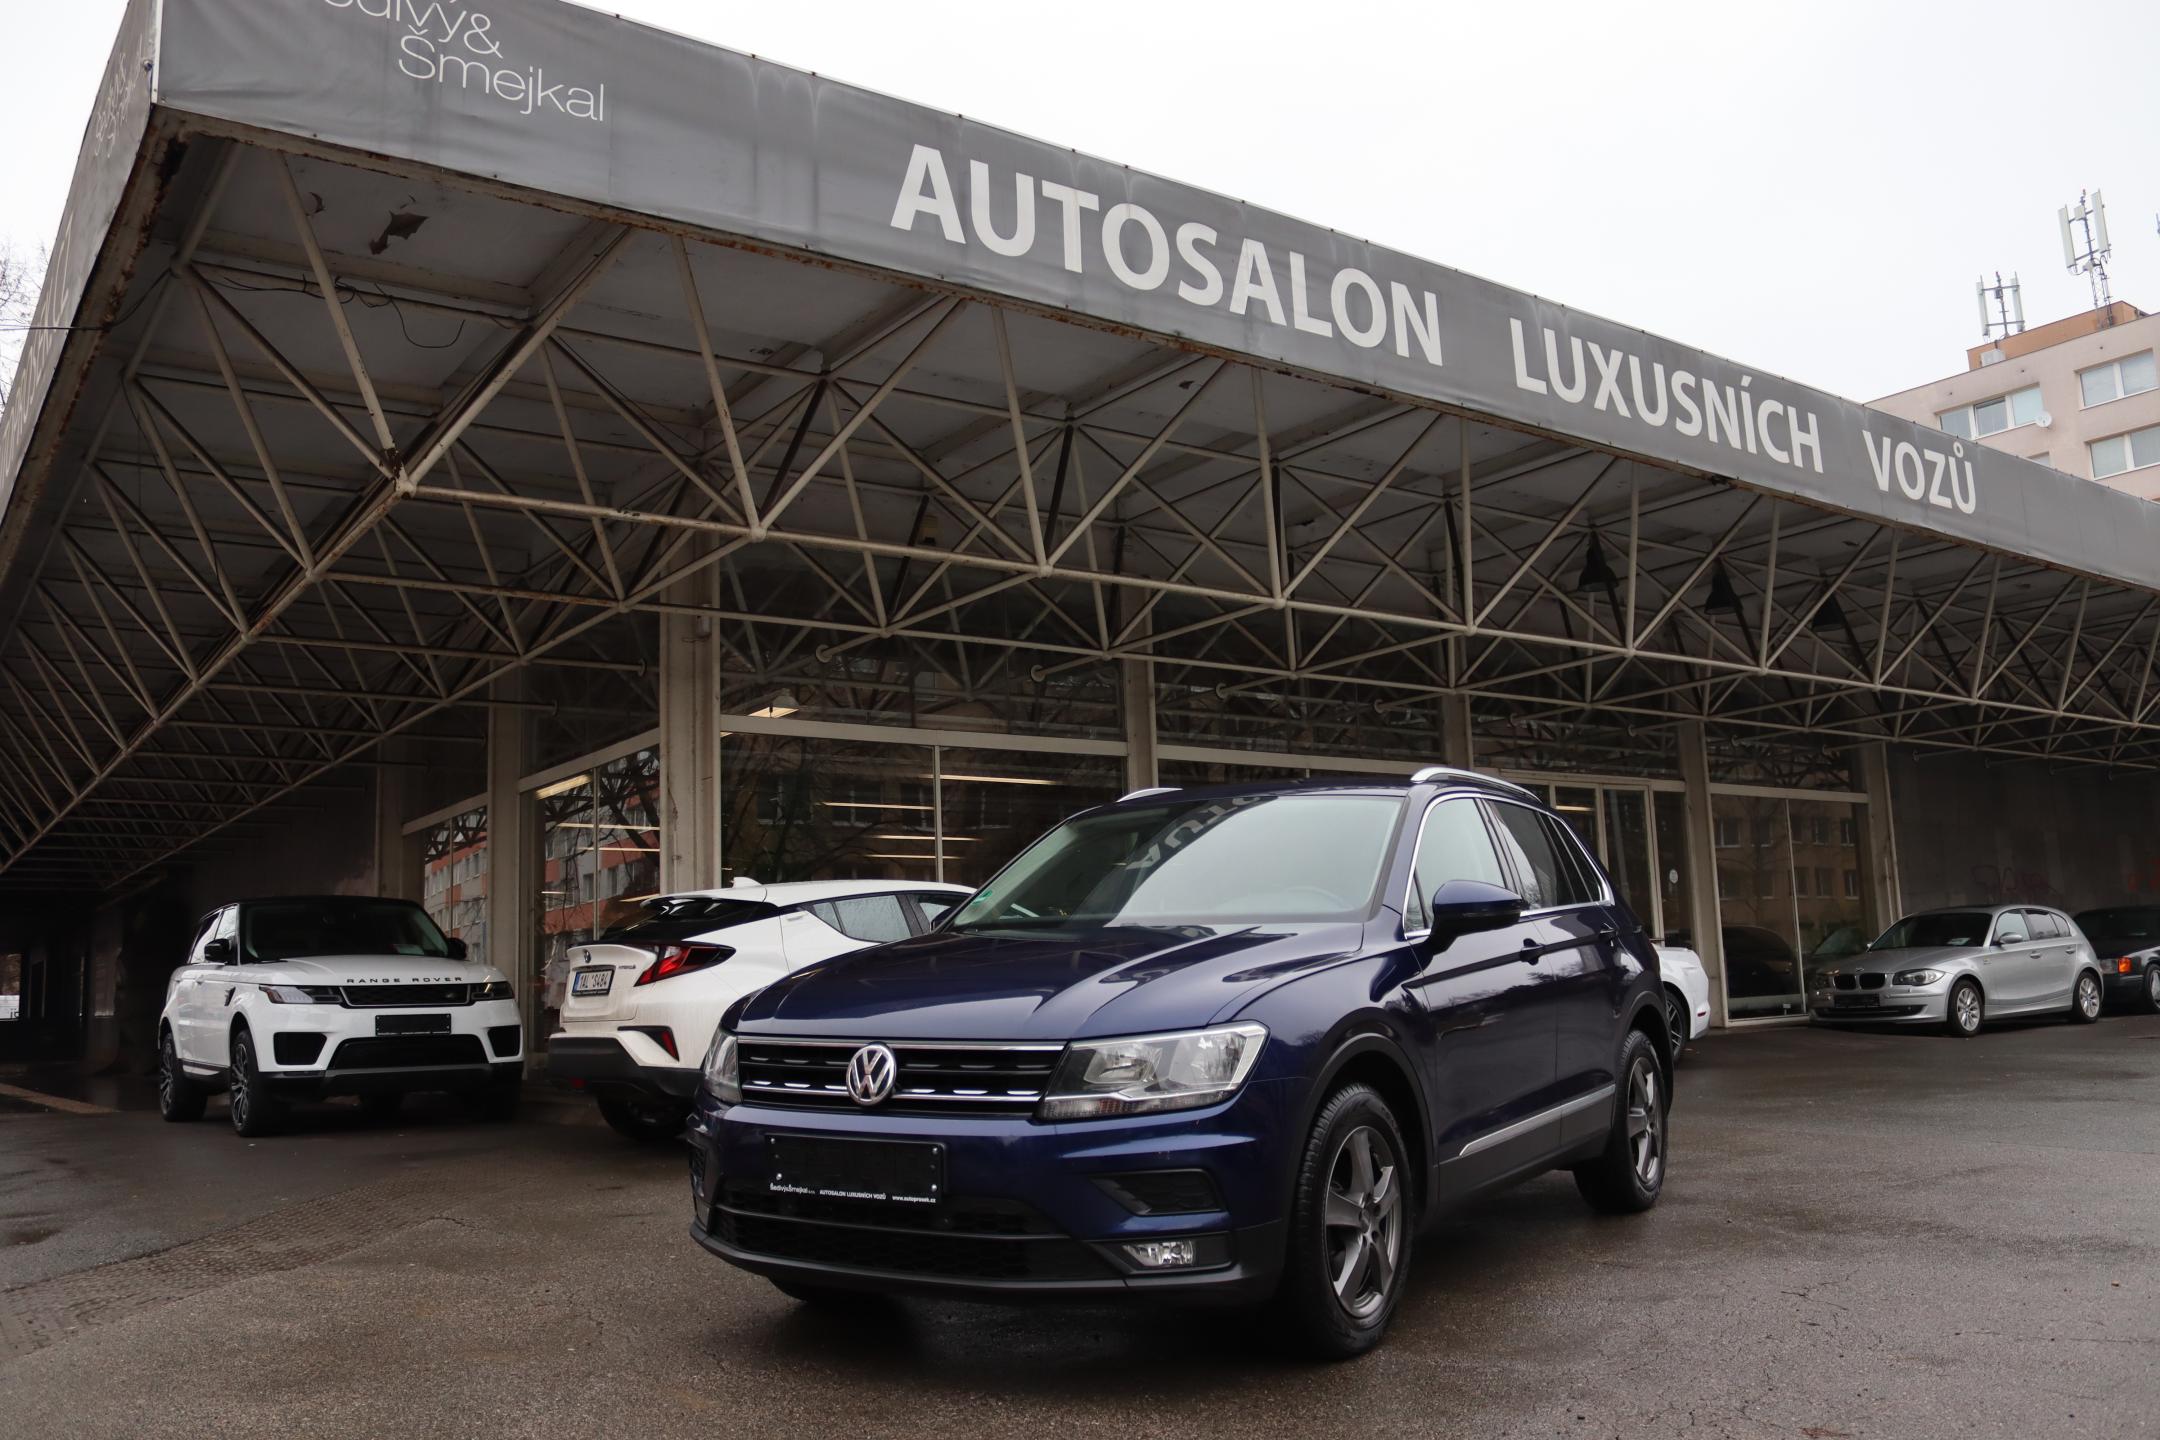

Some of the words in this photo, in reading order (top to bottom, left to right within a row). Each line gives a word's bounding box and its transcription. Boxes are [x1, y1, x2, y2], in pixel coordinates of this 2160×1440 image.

[398, 24, 604, 121] Šmejkal
[890, 143, 1443, 367] AUTOSALON
[1509, 318, 1824, 474] LUXUSNÍCH
[1862, 430, 1977, 514] VOZŮ
